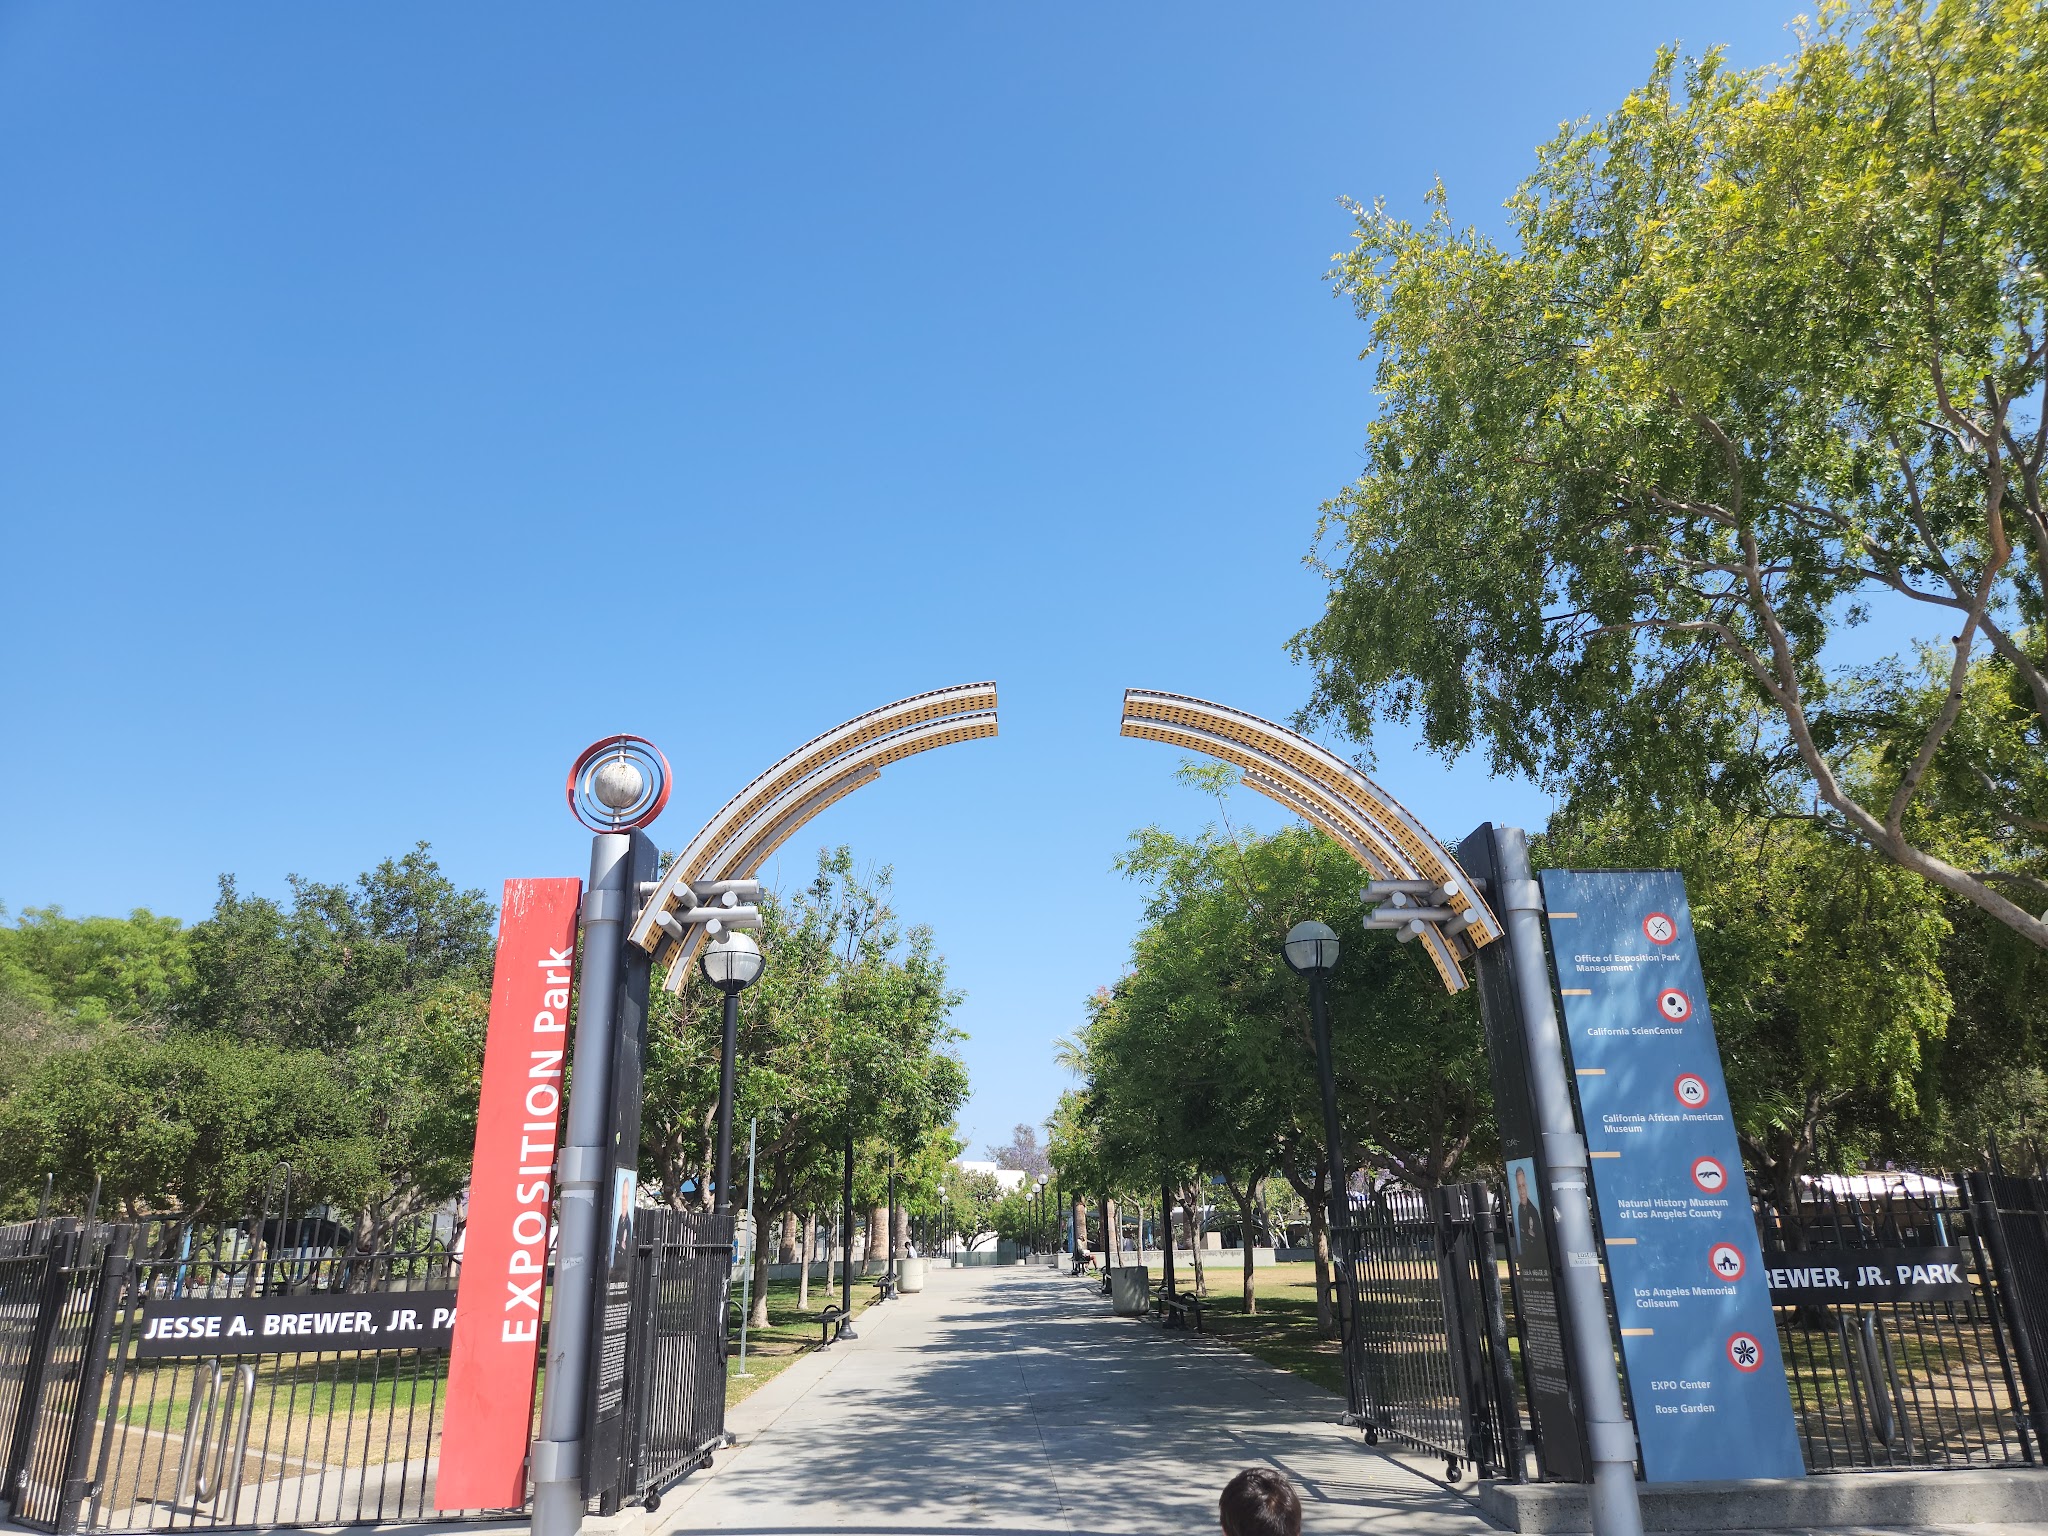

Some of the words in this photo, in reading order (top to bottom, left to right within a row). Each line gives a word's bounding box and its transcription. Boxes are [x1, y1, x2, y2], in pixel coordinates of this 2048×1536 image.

[1574, 954, 1601, 963] Office
[1603, 954, 1612, 962] of
[1614, 953, 1660, 964] Exposition
[1661, 953, 1681, 962] Park
[1575, 964, 1633, 973] Management
[1587, 1027, 1630, 1036] California
[1632, 1027, 1683, 1035] ScienCenter
[1602, 1113, 1646, 1123] California
[1648, 1113, 1680, 1122] African
[1682, 1112, 1724, 1121] American
[1604, 1125, 1643, 1133] Museum
[502, 1051, 562, 1343] EXPOSITION
[533, 945, 573, 1033] Park
[1617, 1199, 1652, 1208] Natural
[1654, 1198, 1687, 1209] History
[1689, 1198, 1729, 1207] Museum
[1619, 1210, 1630, 1219] of
[1632, 1209, 1648, 1218] Los
[1650, 1209, 1687, 1219] Angeles
[1689, 1209, 1722, 1219] County
[1856, 1266, 1891, 1287] JR.
[1896, 1263, 1964, 1285] PARK
[1634, 1288, 1650, 1297] Los
[1652, 1287, 1690, 1298] Angeles
[1692, 1286, 1737, 1296] Memorial
[1636, 1299, 1679, 1308] Coliseum
[144, 1315, 222, 1339] JESSE
[227, 1315, 254, 1336] A.
[262, 1311, 379, 1335] BREWER,
[386, 1309, 424, 1331] JR.
[1651, 1381, 1677, 1390] EXPO
[1679, 1381, 1711, 1389] Center
[1655, 1405, 1679, 1413] Rose
[1680, 1404, 1715, 1413] Garden
